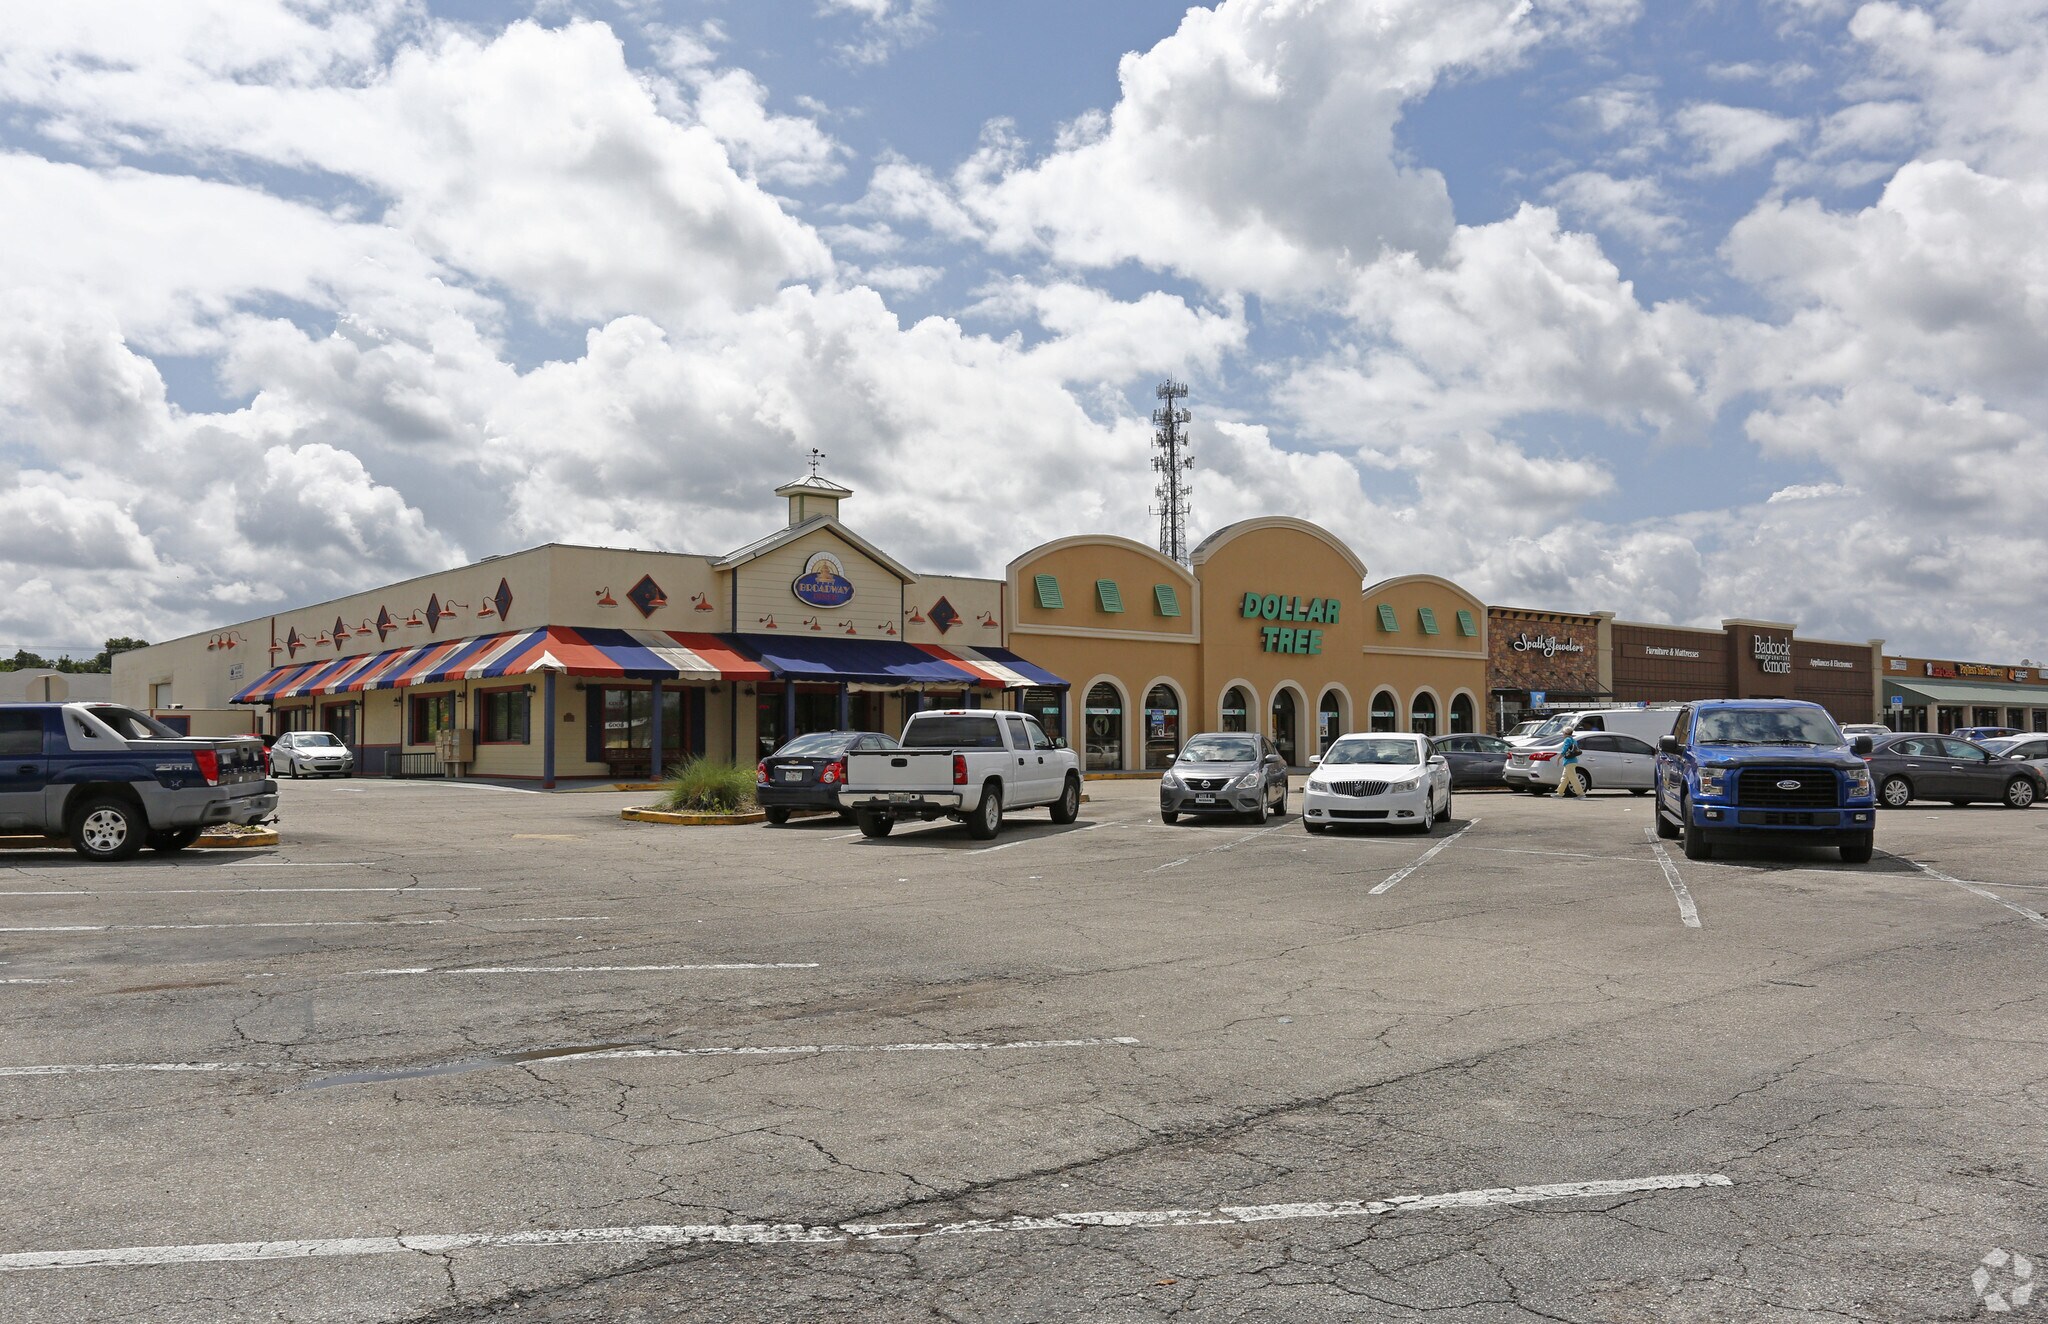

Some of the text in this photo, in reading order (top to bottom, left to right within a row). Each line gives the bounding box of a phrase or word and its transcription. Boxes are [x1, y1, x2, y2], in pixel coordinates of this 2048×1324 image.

[800, 584, 849, 594] BROADWAY
[1242, 592, 1341, 624] DOLLAR
[1262, 626, 1323, 655] TREE
[1513, 633, 1584, 657] Spath Jewelers
[1754, 634, 1791, 655] Badcock
[1645, 646, 1699, 658] Furniture & Mattresses
[1810, 658, 1830, 667] Appliances
[1833, 660, 1853, 668] Electronics
